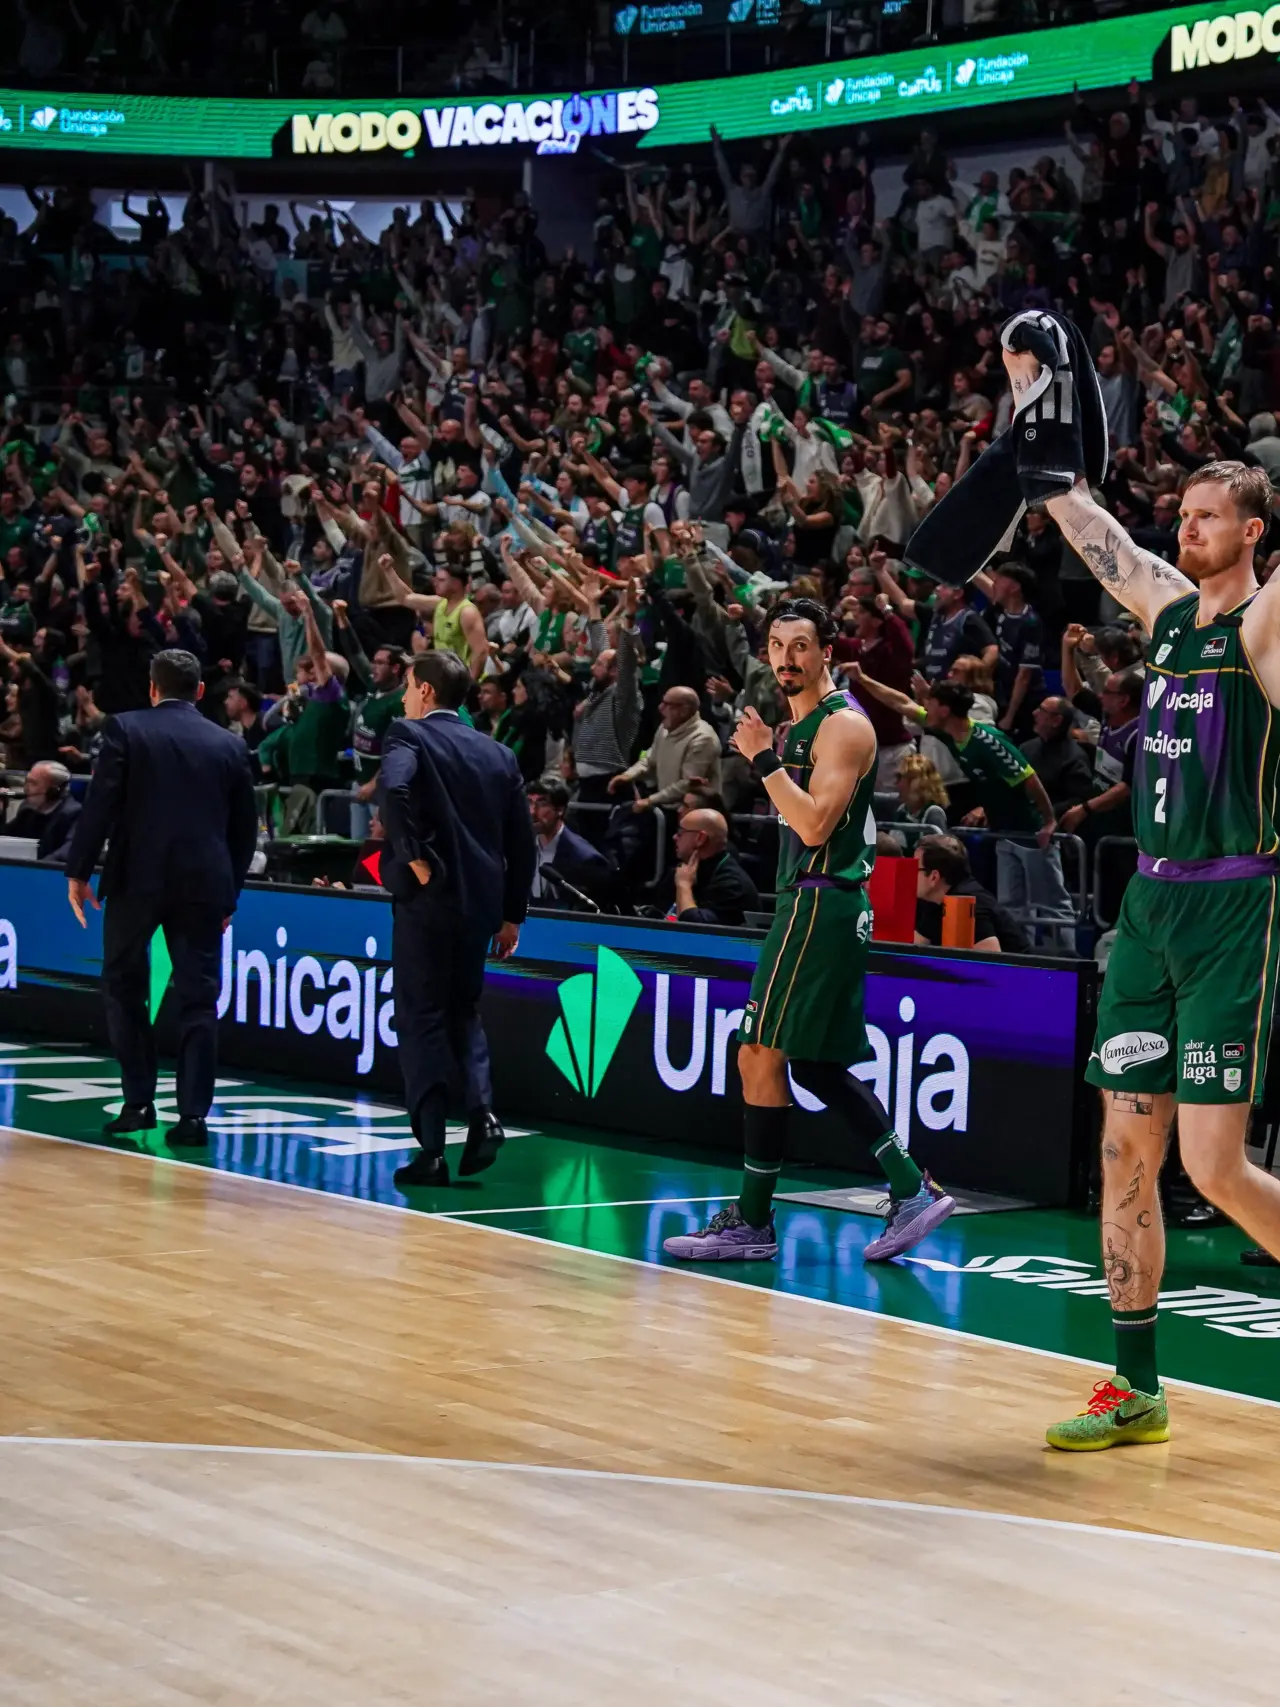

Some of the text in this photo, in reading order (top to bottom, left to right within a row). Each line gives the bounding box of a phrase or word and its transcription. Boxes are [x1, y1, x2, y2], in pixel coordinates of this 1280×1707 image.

[292, 110, 422, 153] MODO
[422, 88, 660, 148] VACACIONES
[1103, 1034, 1165, 1063] famadesa
[1184, 1039, 1205, 1050] sabor
[1182, 1062, 1218, 1085] laga
